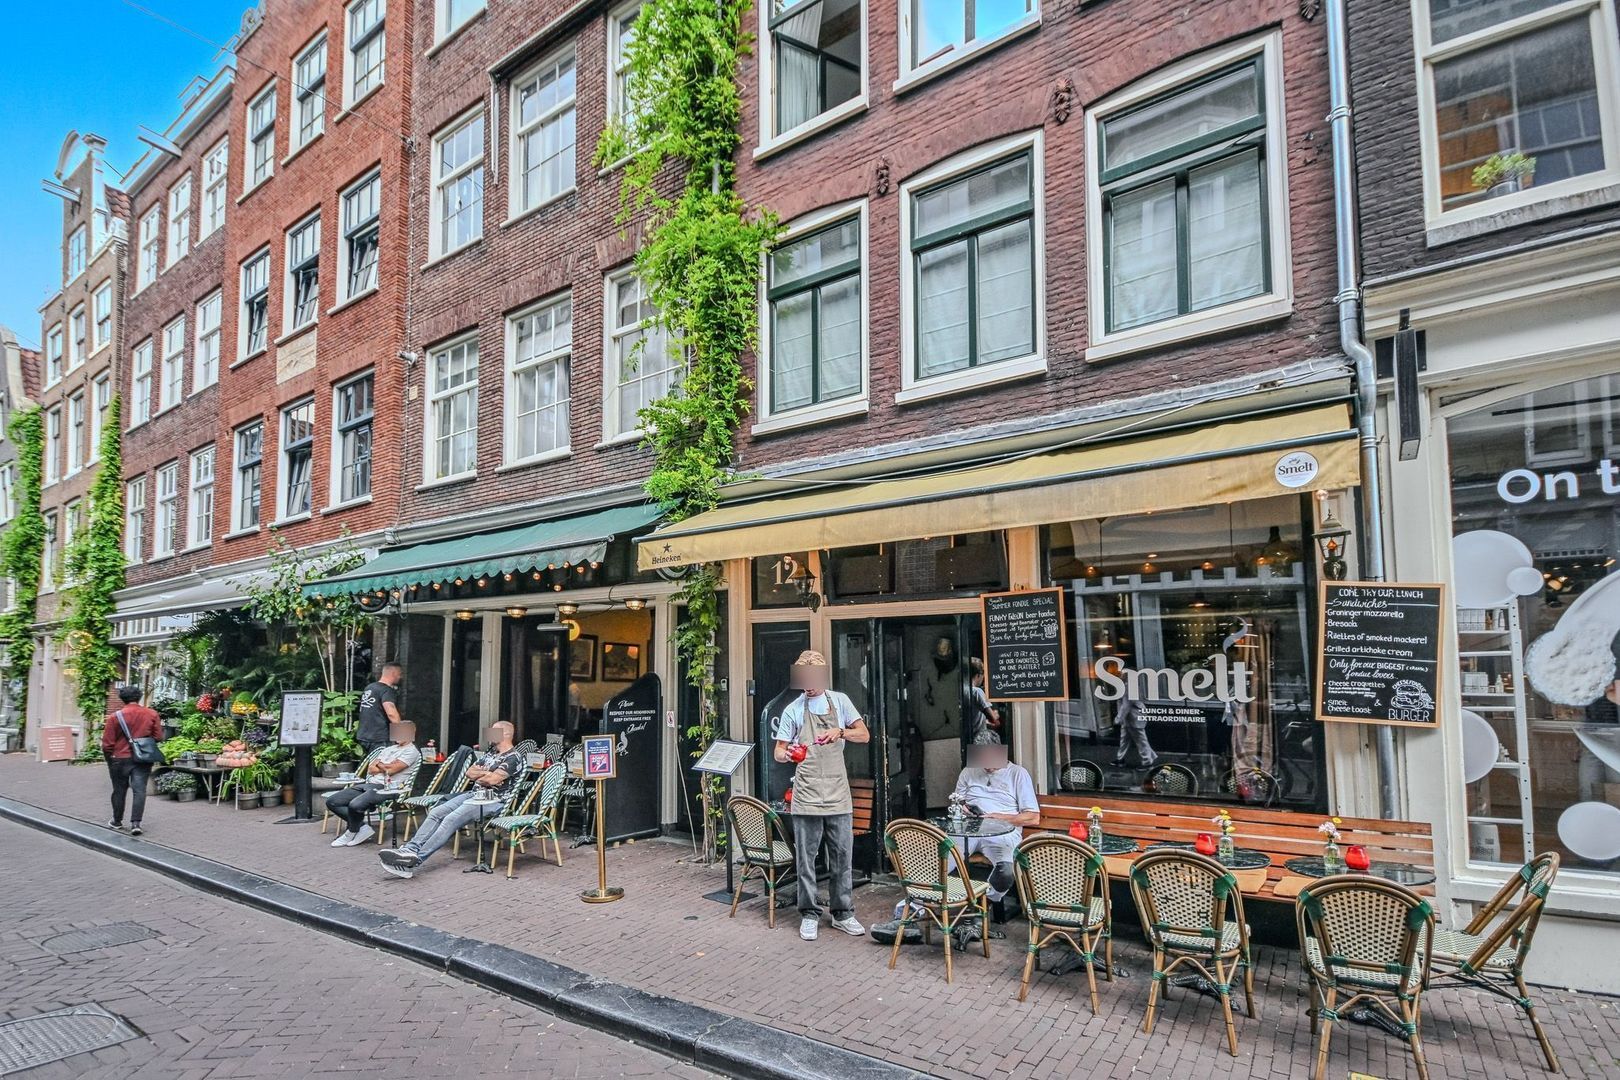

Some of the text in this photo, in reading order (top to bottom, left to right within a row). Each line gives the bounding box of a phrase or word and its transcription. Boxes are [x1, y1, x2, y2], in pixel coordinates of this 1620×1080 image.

[1278, 462, 1313, 475] Smelt
[1497, 468, 1579, 503] On
[651, 554, 682, 565] Heineken
[770, 556, 798, 585] 12
[1339, 587, 1424, 599] COME TRY OUR LUNCH
[1032, 597, 1054, 606] SPECIAL
[1332, 598, 1388, 609] Sandwiches
[1356, 633, 1366, 641] of
[1365, 634, 1393, 642] smoked
[1326, 645, 1413, 657] Grilled artichoke cream
[1329, 658, 1349, 673] Only
[1376, 663, 1406, 671] BIGGEST
[1094, 653, 1256, 703] Smelt
[1351, 706, 1373, 714] toast
[1388, 708, 1430, 722] BURGER
[1137, 715, 1206, 723] EXTRAORDINAIRE
